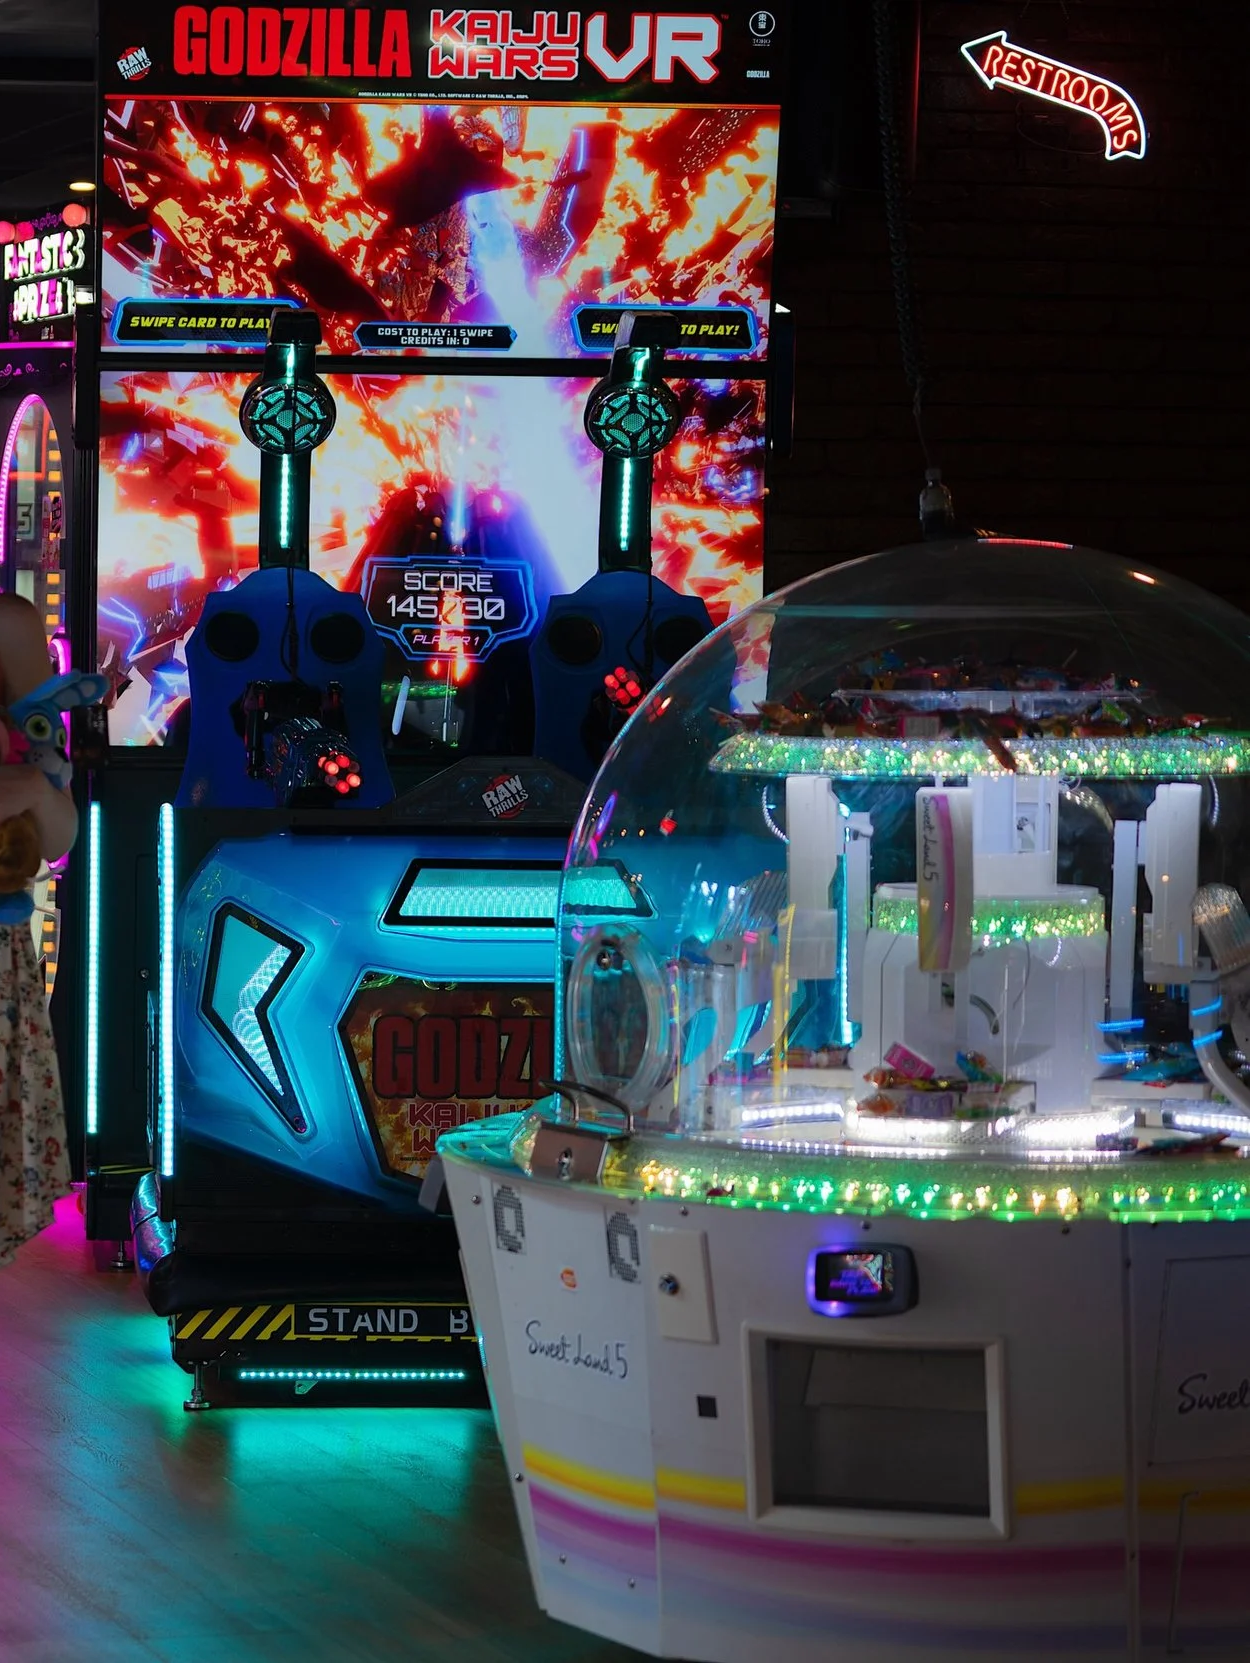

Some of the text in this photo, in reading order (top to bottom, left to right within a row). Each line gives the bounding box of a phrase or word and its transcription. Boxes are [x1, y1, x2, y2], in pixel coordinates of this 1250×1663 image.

[173, 6, 412, 77] GODZILLA
[430, 10, 580, 46] KAIJU
[116, 47, 149, 71] RAW
[585, 12, 722, 83] VR
[121, 59, 152, 81] THRILLS
[428, 45, 580, 80] WARS
[981, 45, 1138, 150] RESTROOMS
[130, 316, 270, 329] SWIPE CARD TO PLAY
[377, 328, 403, 336] COST
[407, 328, 418, 336] TO
[421, 328, 451, 337] PLAY:
[459, 329, 493, 337] SWIPE
[591, 323, 740, 335] SWI TO PLAY!
[401, 337, 444, 345] CREDITS
[446, 337, 460, 345] IN:
[404, 571, 493, 592] SCORE
[412, 634, 480, 646] PLAR 1
[482, 774, 523, 809] RAW
[489, 789, 529, 818] THRILLS
[373, 1014, 554, 1098] GODZI
[308, 1307, 419, 1333] STAND
[526, 1319, 572, 1363] Sweet
[615, 1342, 628, 1380] 5
